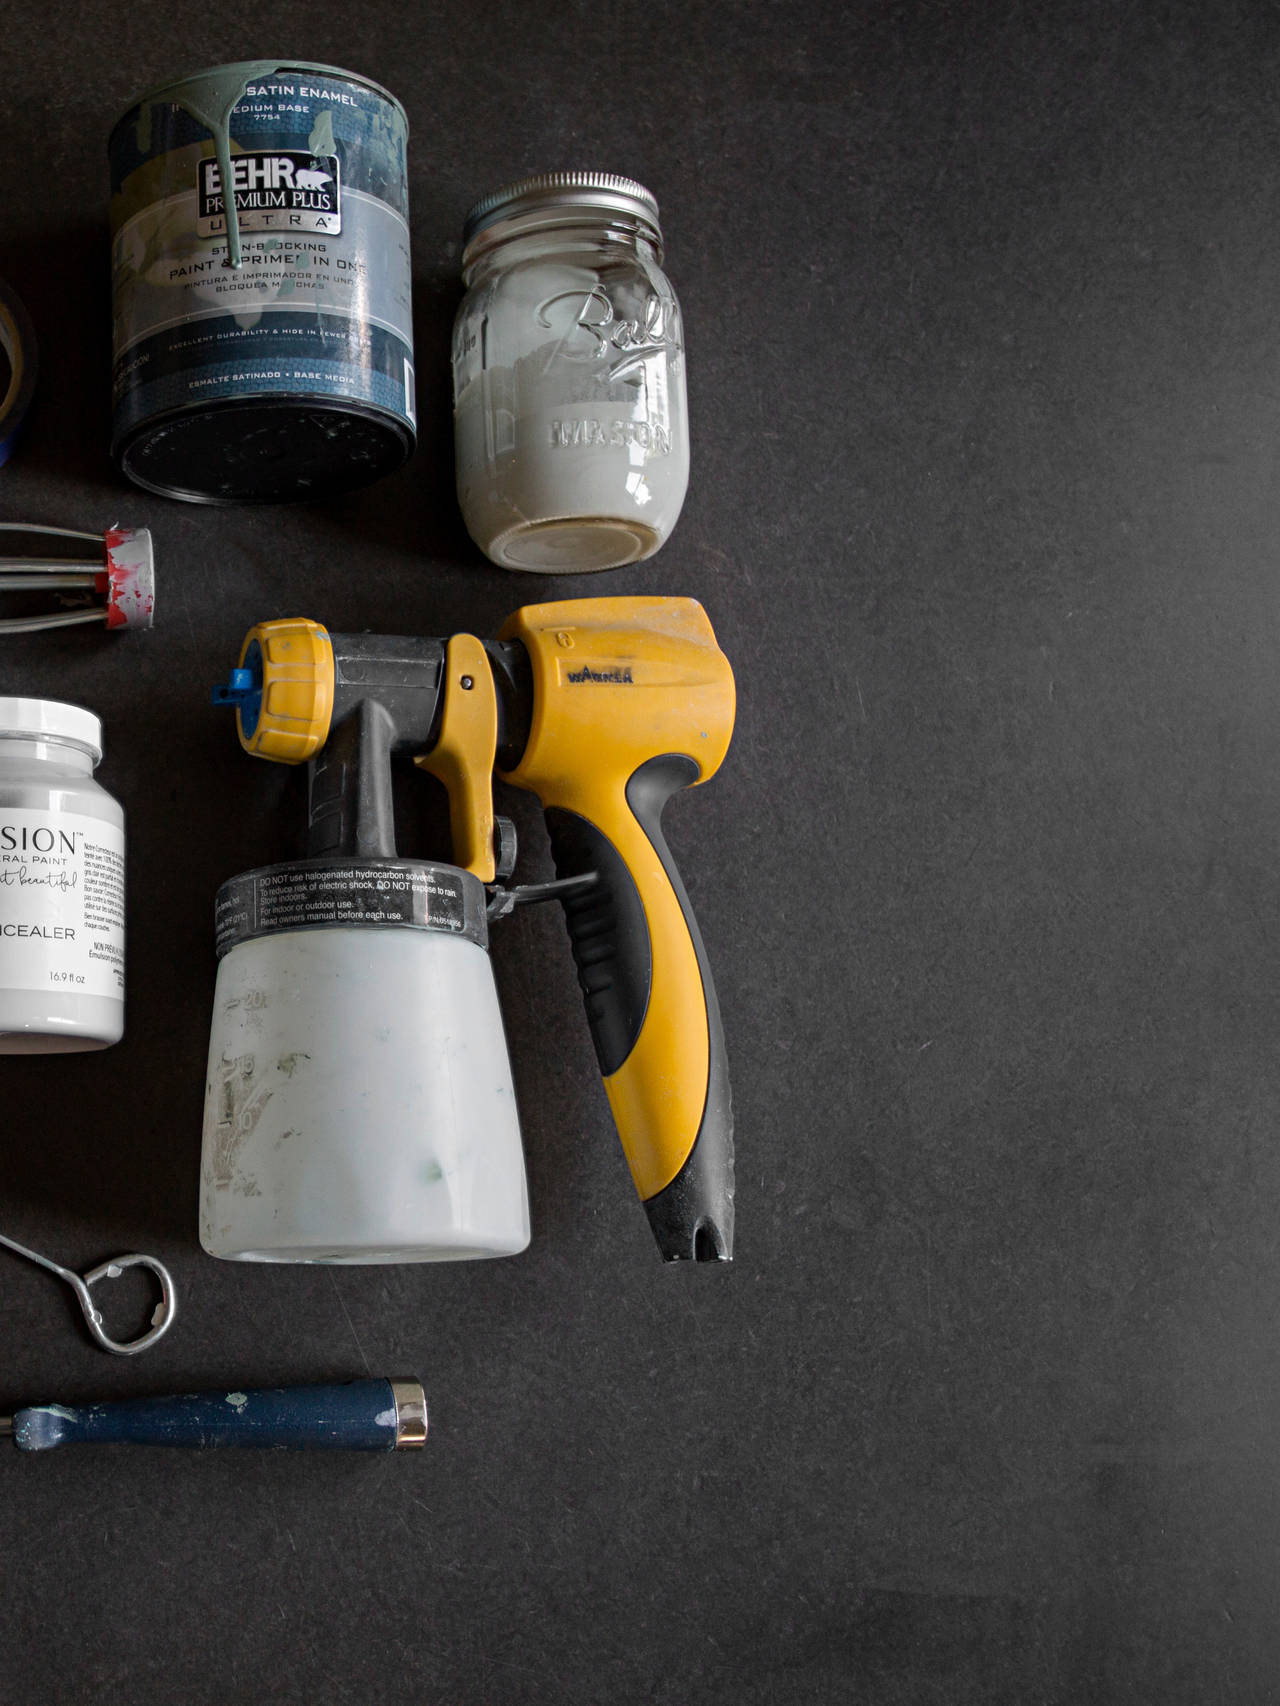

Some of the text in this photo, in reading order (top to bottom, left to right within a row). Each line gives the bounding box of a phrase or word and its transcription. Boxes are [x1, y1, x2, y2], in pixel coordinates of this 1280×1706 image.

[246, 85, 359, 107] SATIN ENAMEL
[232, 103, 310, 114] EDIUM BASE
[292, 191, 331, 210] PLUS
[210, 214, 328, 231] ULTRA
[212, 242, 327, 255] STN-BOCKING
[169, 260, 214, 280] PAINT
[241, 254, 301, 266] PRIME
[314, 256, 329, 266] IN
[184, 275, 228, 290] PINTURA
[243, 271, 312, 280] IMPRIMADOR
[316, 273, 330, 281] EN
[216, 281, 325, 292] BLOQUEA MCHAS
[217, 329, 269, 339] DURABILITY
[189, 375, 230, 389] ESMALTE
[233, 370, 280, 381] SATINADO
[294, 371, 321, 380] BASE
[32, 855, 68, 865] PAINT
[20, 865, 78, 892] beautiful
[272, 875, 288, 885] NOT
[290, 873, 304, 882] use
[305, 869, 354, 882] halogenated
[355, 870, 404, 880] hydrocarbon
[269, 886, 293, 896] reduce
[294, 883, 307, 892] risk
[309, 883, 317, 891] of
[319, 881, 347, 890] electric
[349, 880, 375, 890] shock,
[392, 881, 410, 891] NOT
[437, 887, 444, 896] to
[272, 903, 294, 914] indoor
[295, 903, 304, 911] or
[305, 900, 336, 910] outdoor
[337, 900, 354, 908] use.
[307, 911, 336, 921] manual
[337, 911, 363, 920] before
[365, 910, 385, 920] each
[387, 912, 404, 920] use.
[50, 971, 68, 983] 16.9
[76, 975, 86, 984] oz
